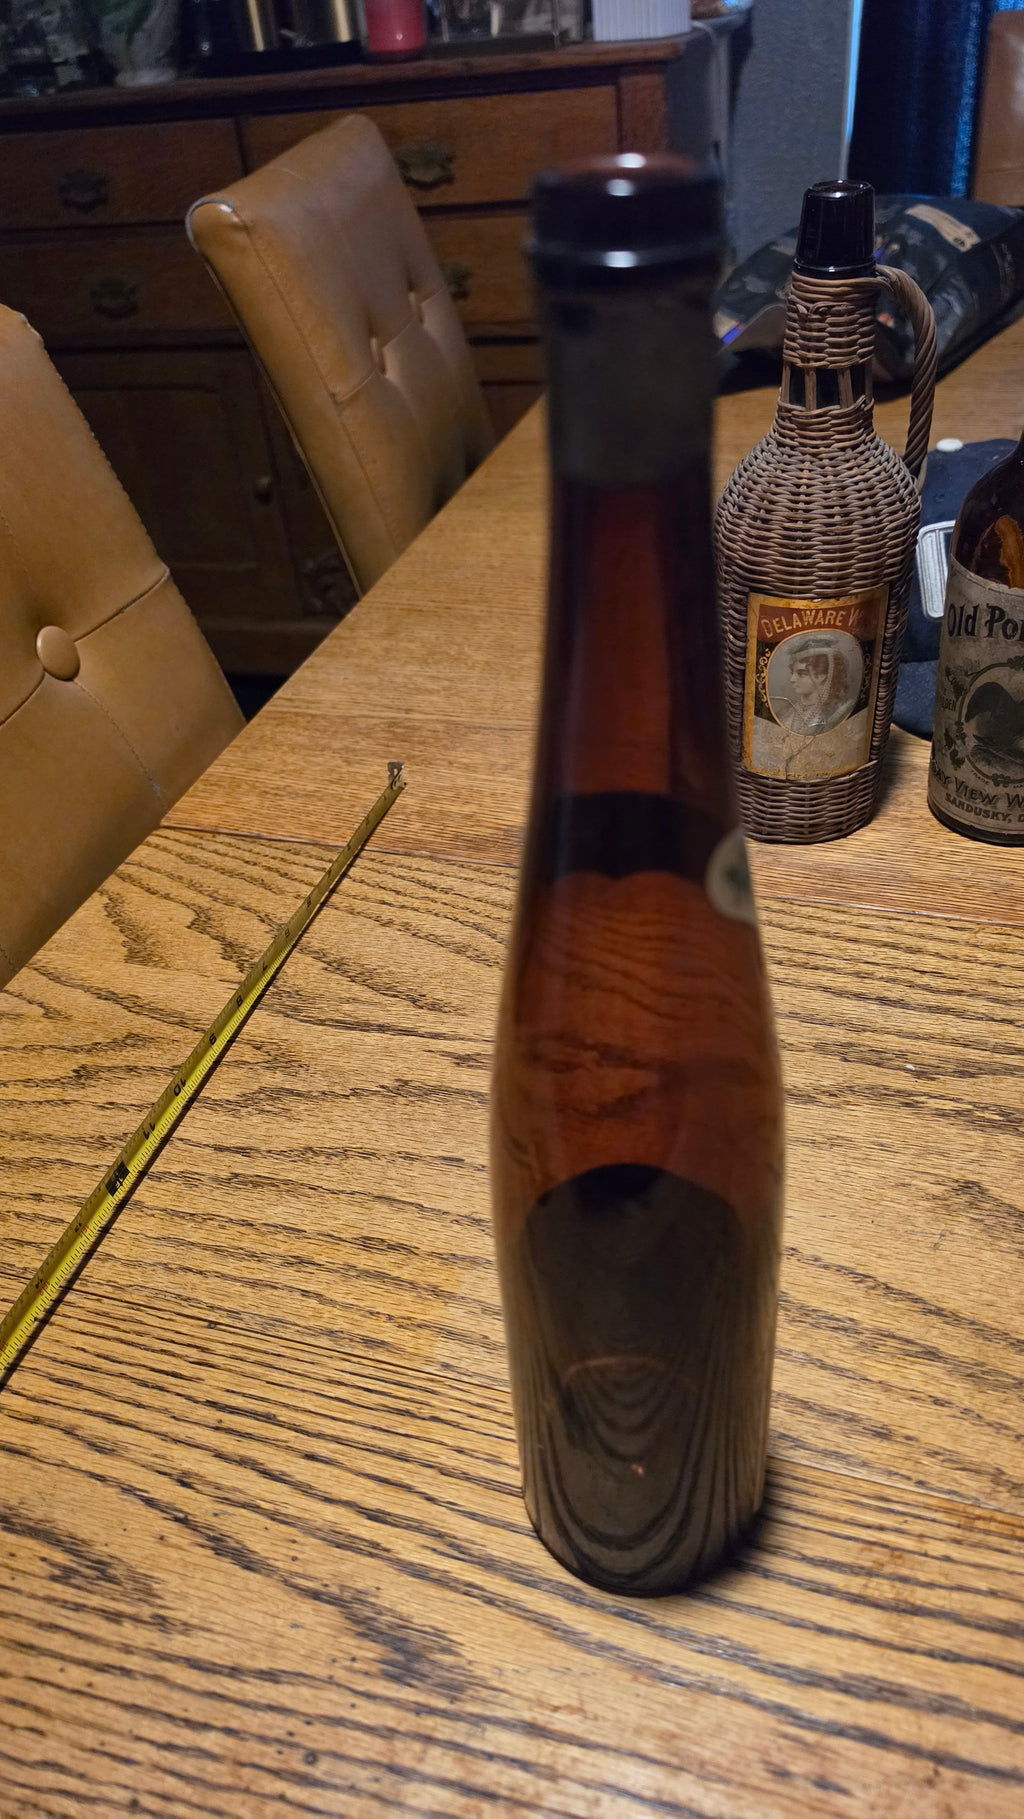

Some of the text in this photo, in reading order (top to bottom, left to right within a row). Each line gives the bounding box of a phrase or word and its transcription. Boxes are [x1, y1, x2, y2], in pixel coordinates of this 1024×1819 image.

[761, 609, 846, 638] DELAWARE
[947, 603, 979, 637] Old
[954, 776, 998, 805] VIEW
[944, 792, 1013, 824] SANDUSKY,
[235, 995, 243, 1007] 8
[209, 1032, 217, 1046] 9
[174, 1079, 187, 1097] 10
[143, 1122, 156, 1140] 11
